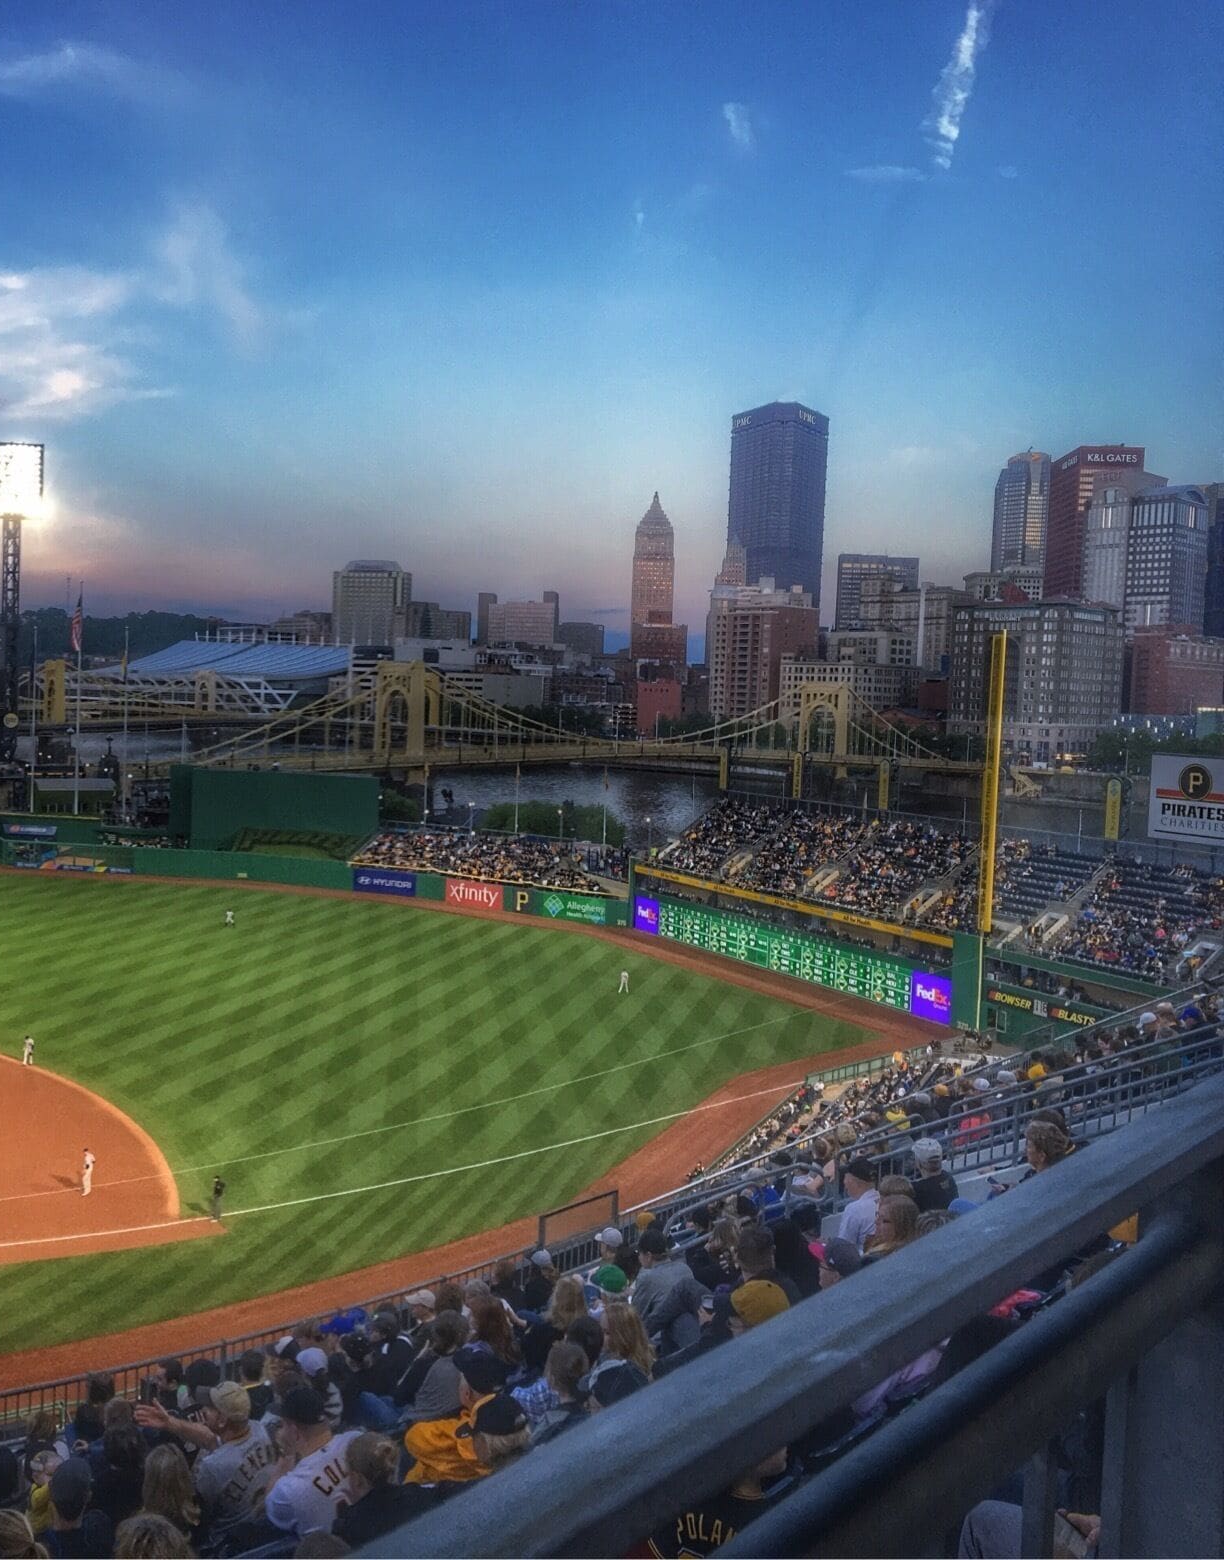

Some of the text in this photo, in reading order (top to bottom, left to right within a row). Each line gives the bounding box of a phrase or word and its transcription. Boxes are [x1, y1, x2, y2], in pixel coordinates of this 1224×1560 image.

[799, 409, 817, 425] UPMC
[1087, 453, 1137, 463] K&L GATES
[1188, 772, 1203, 793] P
[1161, 803, 1224, 821] PIRATES
[373, 878, 412, 890] HYUNDAI
[450, 883, 498, 907] xfinity
[516, 891, 528, 911] P
[566, 901, 605, 915] Allegheny
[994, 991, 1032, 1011] BOWSER
[1058, 1009, 1096, 1026] BLASTS
